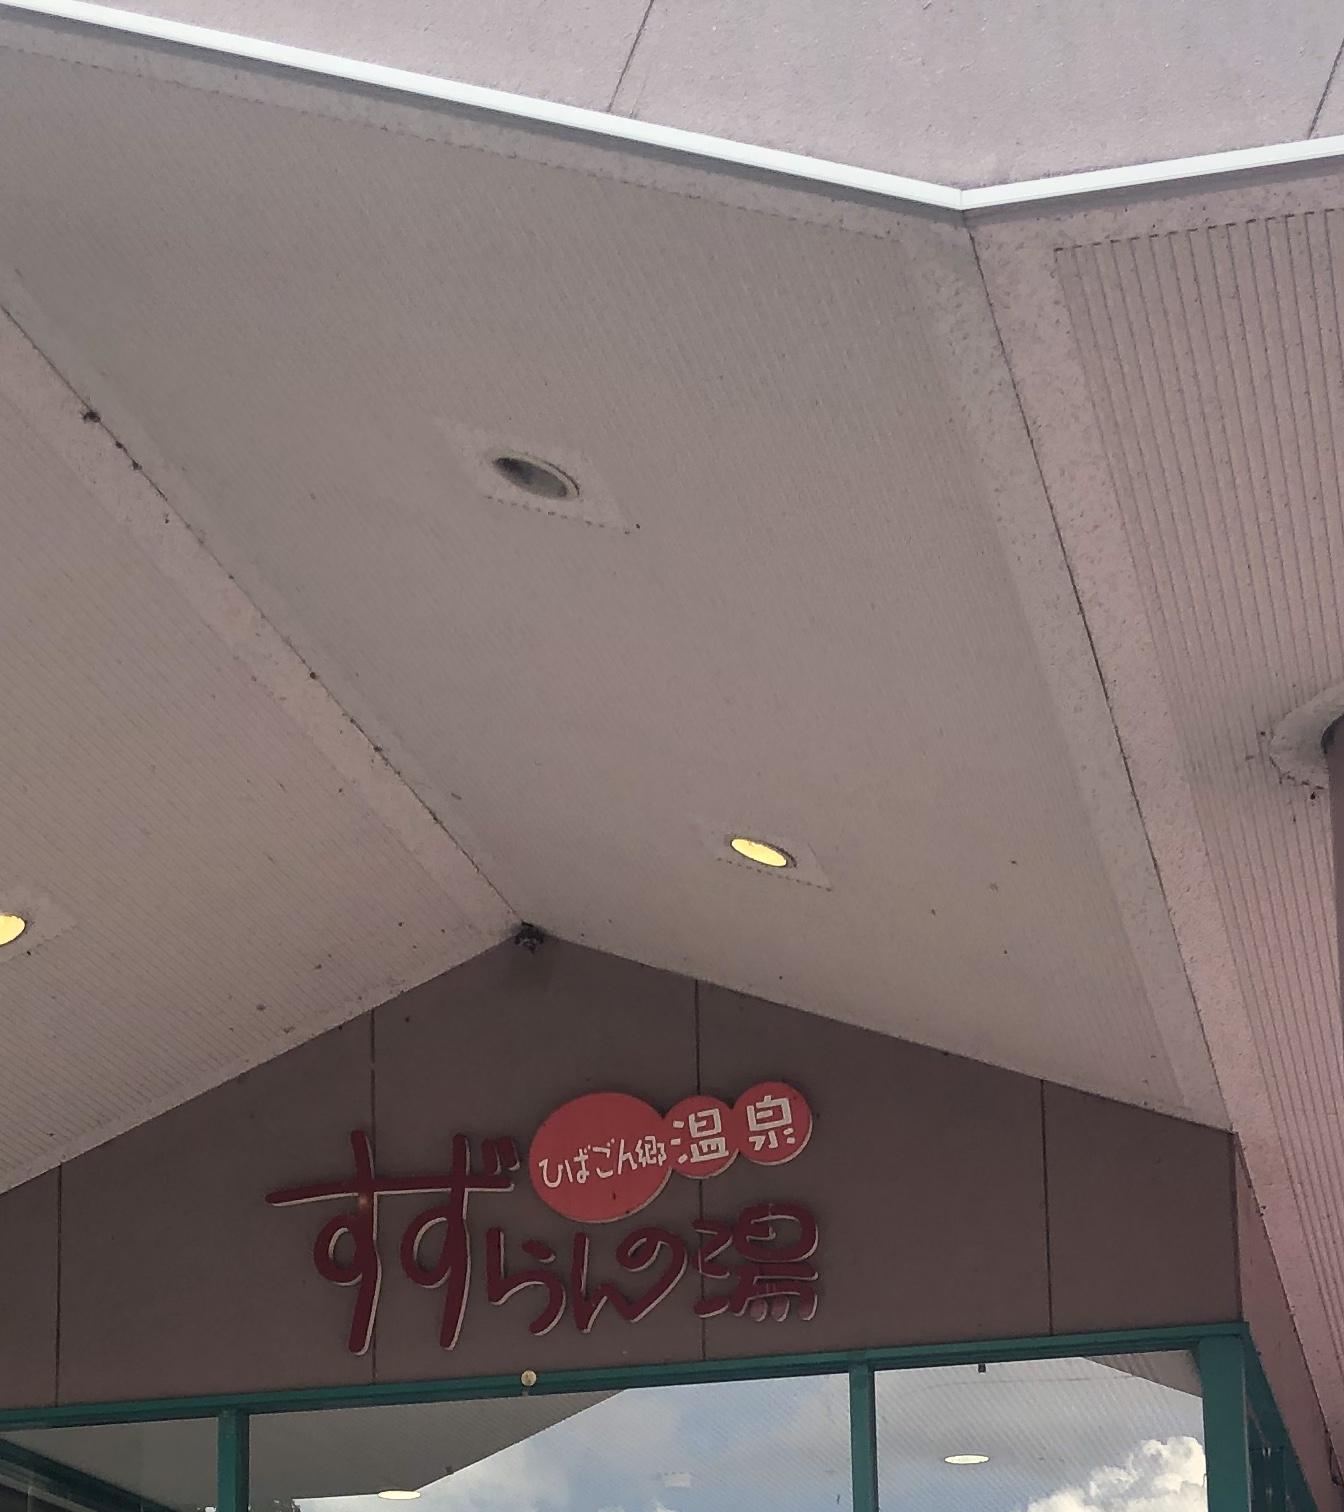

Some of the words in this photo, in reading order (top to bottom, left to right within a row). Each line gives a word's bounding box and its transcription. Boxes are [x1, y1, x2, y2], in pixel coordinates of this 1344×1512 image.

[538, 1094, 796, 1190] ひばごん郷温泉
[264, 1129, 820, 1355] すずらんの湯
